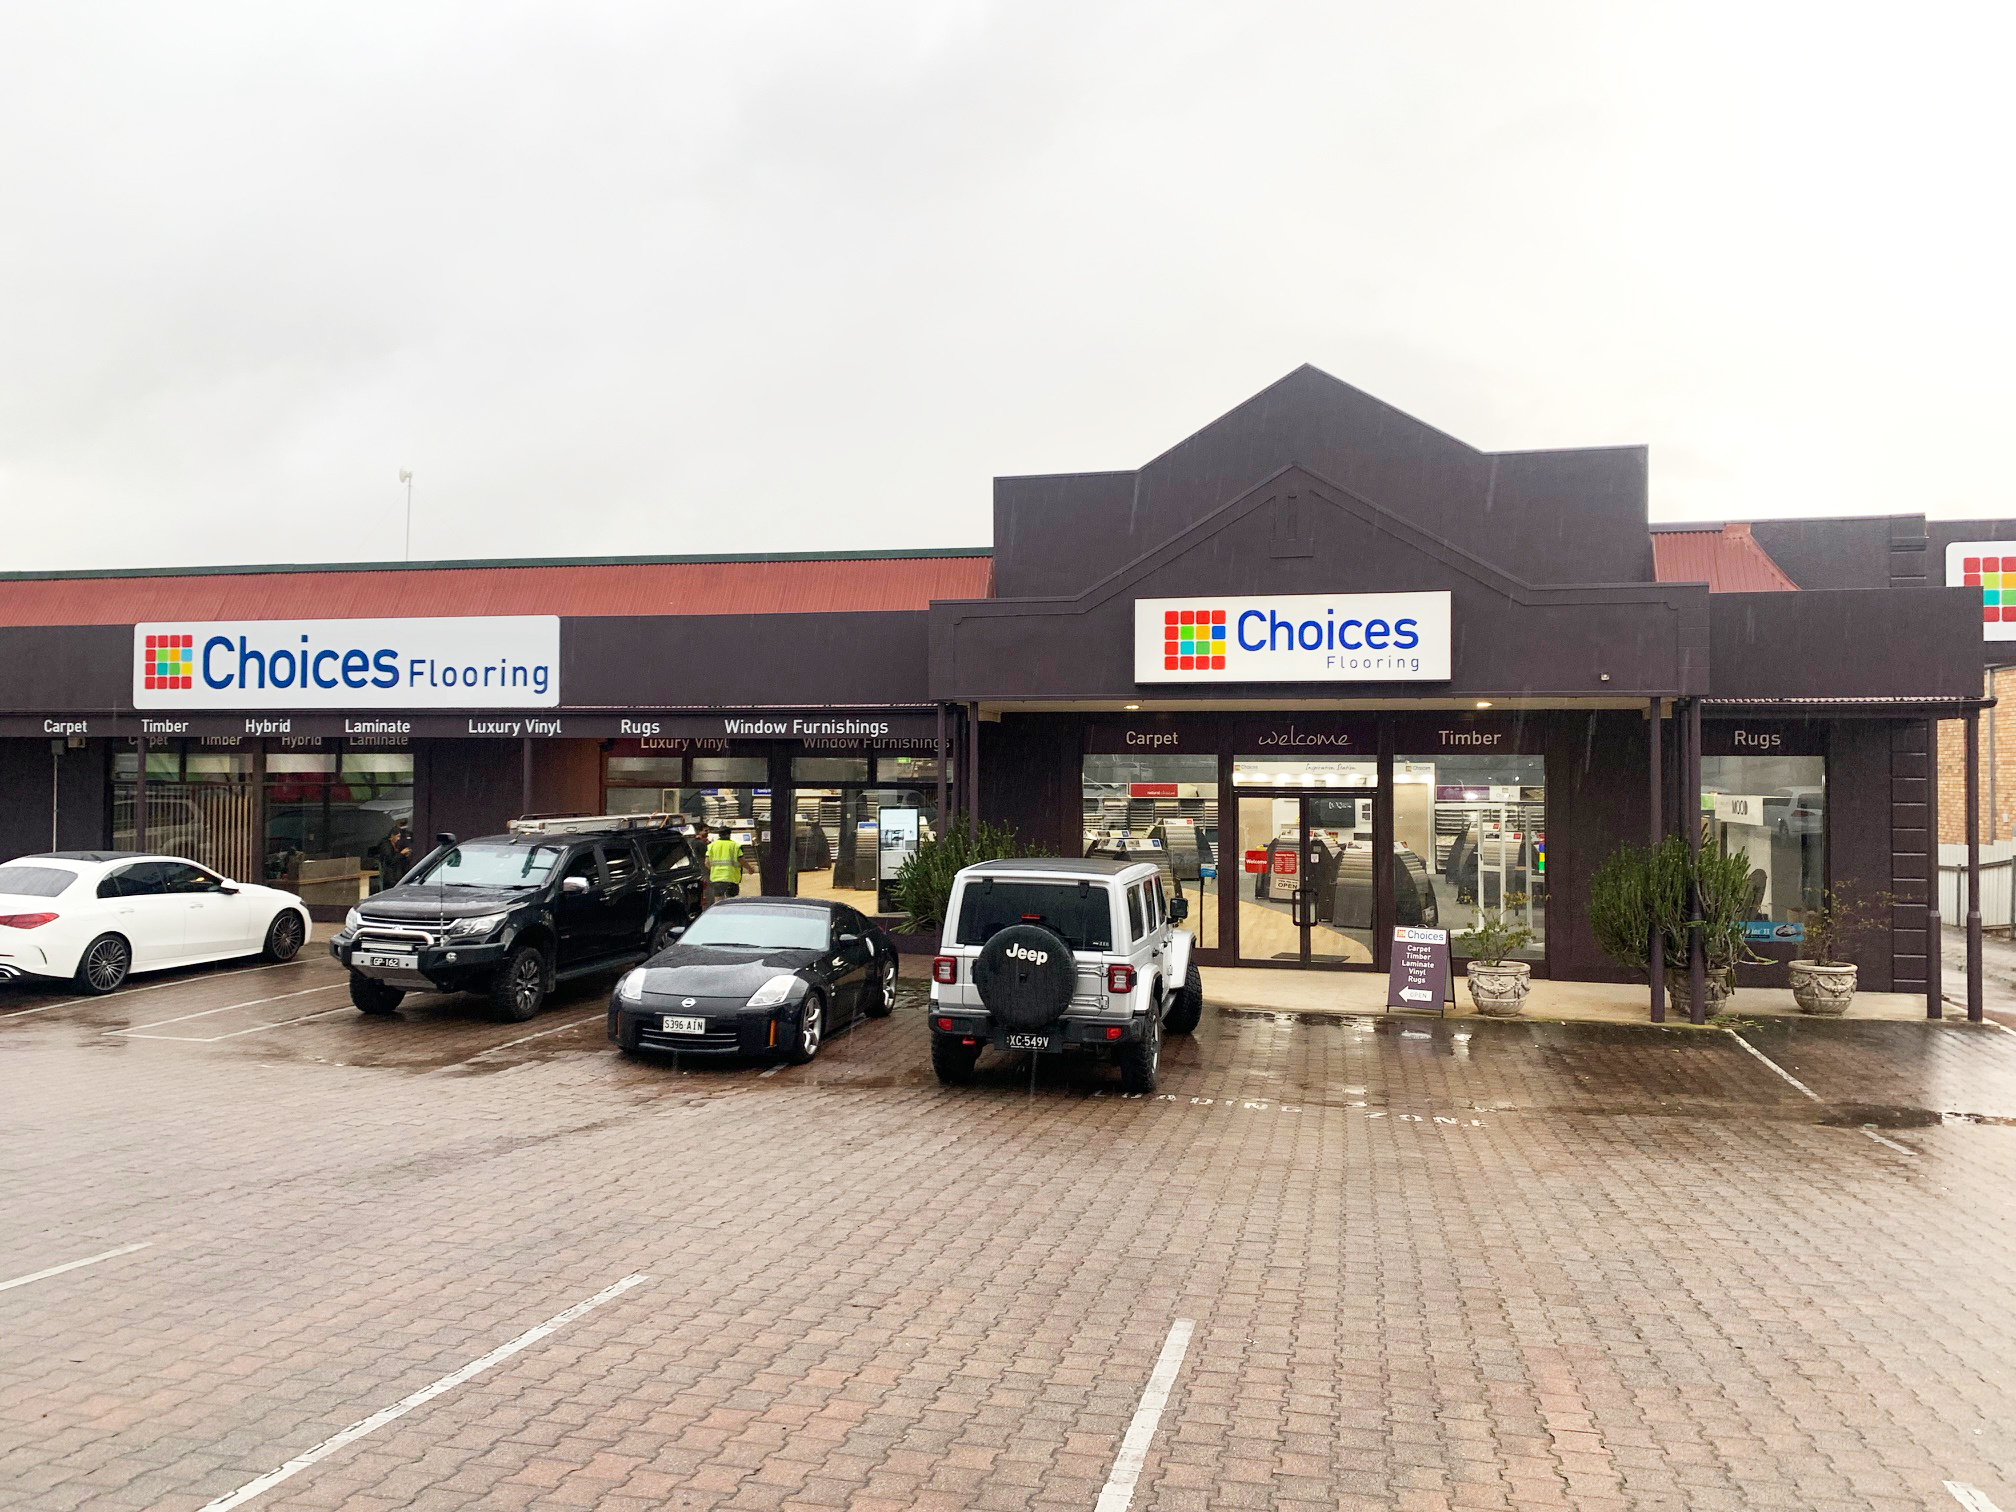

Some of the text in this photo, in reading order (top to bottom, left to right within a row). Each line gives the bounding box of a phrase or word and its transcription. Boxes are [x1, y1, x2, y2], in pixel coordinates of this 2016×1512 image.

[1238, 608, 1419, 652] Choices
[203, 635, 550, 694] Choices Flooring
[1327, 655, 1420, 672] Flooring
[43, 719, 88, 735] Carpet
[141, 718, 189, 733] Timber
[245, 718, 291, 735] Hybrid
[345, 719, 411, 733] Laminate
[468, 718, 562, 736] Luxury Vinyl
[620, 719, 660, 737] Rugs
[724, 719, 889, 737] Window Furnishings
[128, 737, 169, 748] Cpet
[350, 736, 408, 746] Laminate
[803, 738, 859, 748] Window
[1126, 731, 1179, 747] Carpet
[1258, 725, 1352, 746] welcome
[1438, 730, 1501, 745] Timber
[1734, 730, 1781, 749] Rugs
[640, 738, 690, 751] Luxury
[1277, 882, 1298, 890] OPEN
[1407, 929, 1444, 941] Choices
[1005, 942, 1048, 966] Jeep
[1407, 944, 1431, 953] Carpet
[1401, 959, 1435, 969] Laminate
[1406, 952, 1432, 961] Timber
[1408, 967, 1426, 976] Vinyl
[1408, 976, 1426, 984] Rugs
